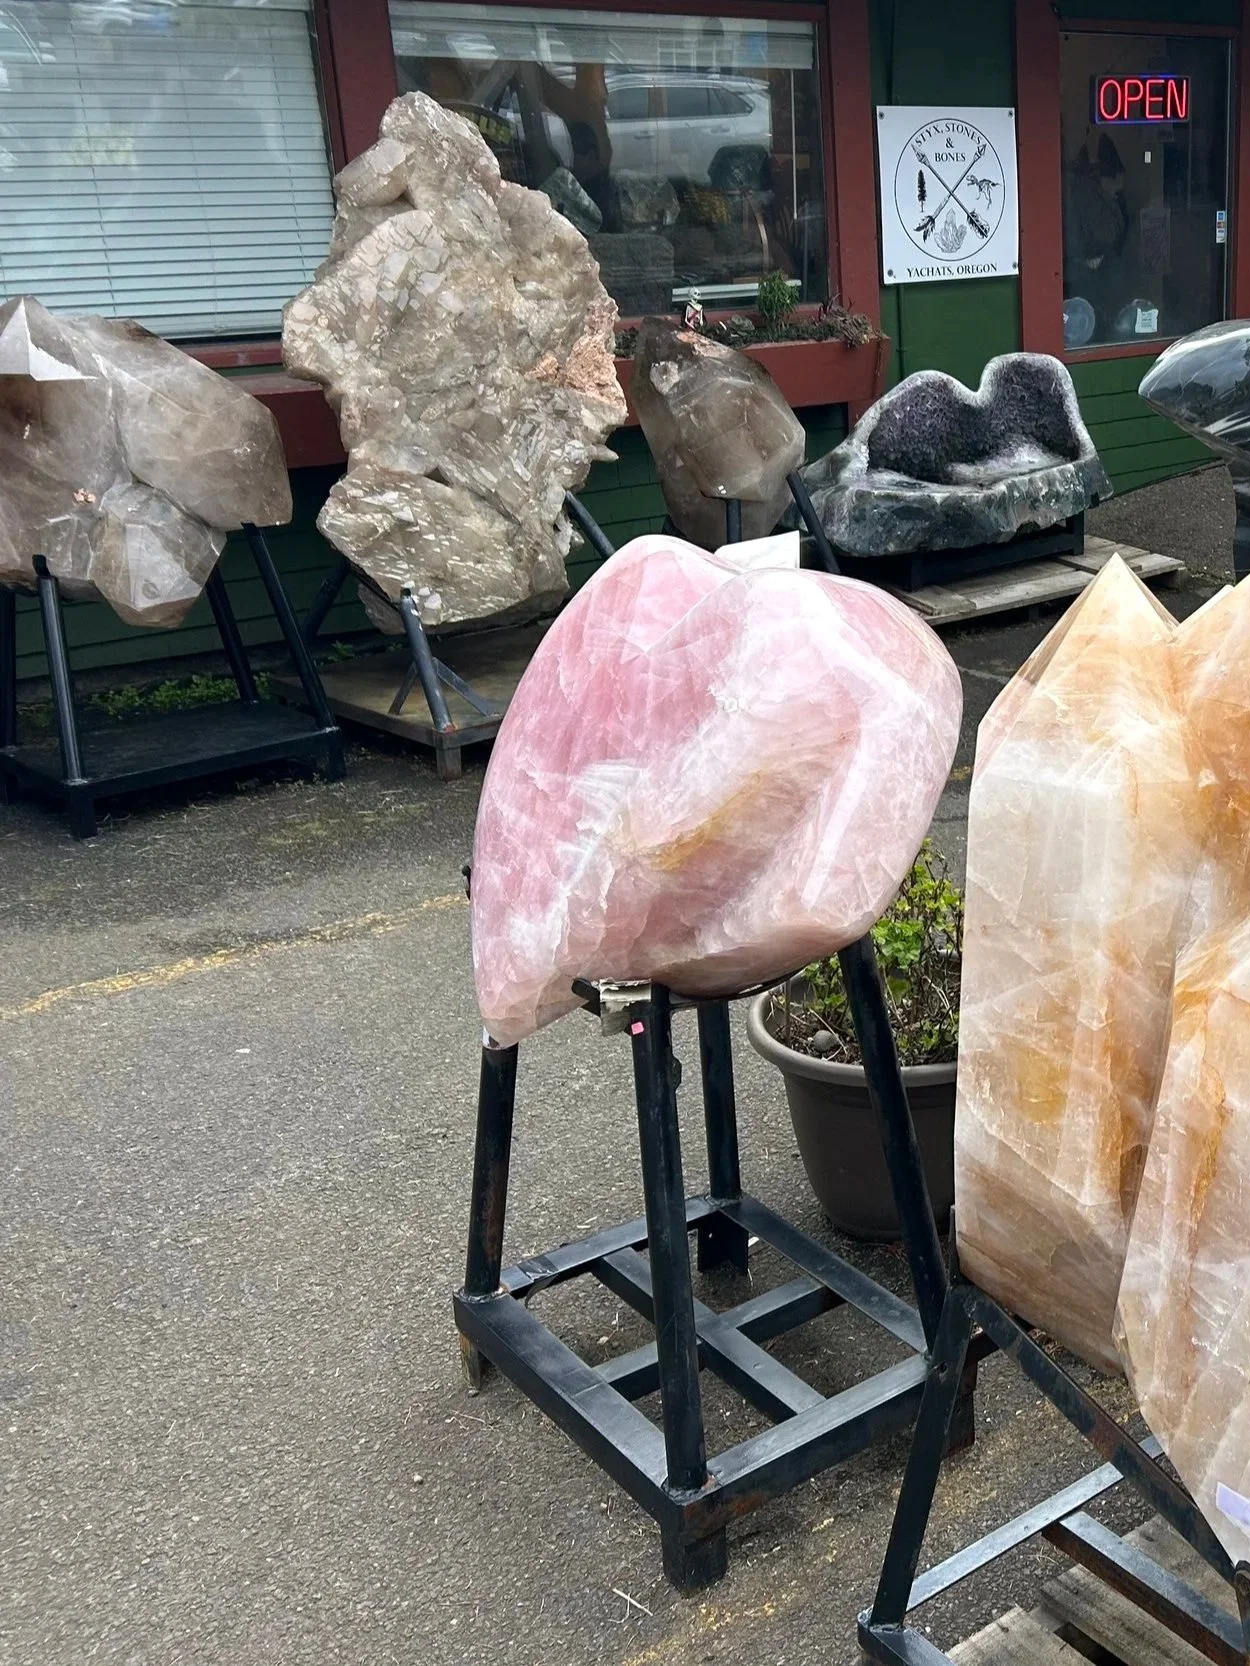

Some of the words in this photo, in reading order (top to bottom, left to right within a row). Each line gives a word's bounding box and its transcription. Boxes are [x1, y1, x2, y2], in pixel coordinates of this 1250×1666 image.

[1099, 79, 1188, 120] OPEN
[915, 124, 944, 146] STYX,
[945, 122, 982, 145] STONES
[945, 137, 954, 149] &
[935, 152, 966, 163] BONES
[906, 266, 954, 278] YACHATS,
[957, 263, 998, 275] OREGON
